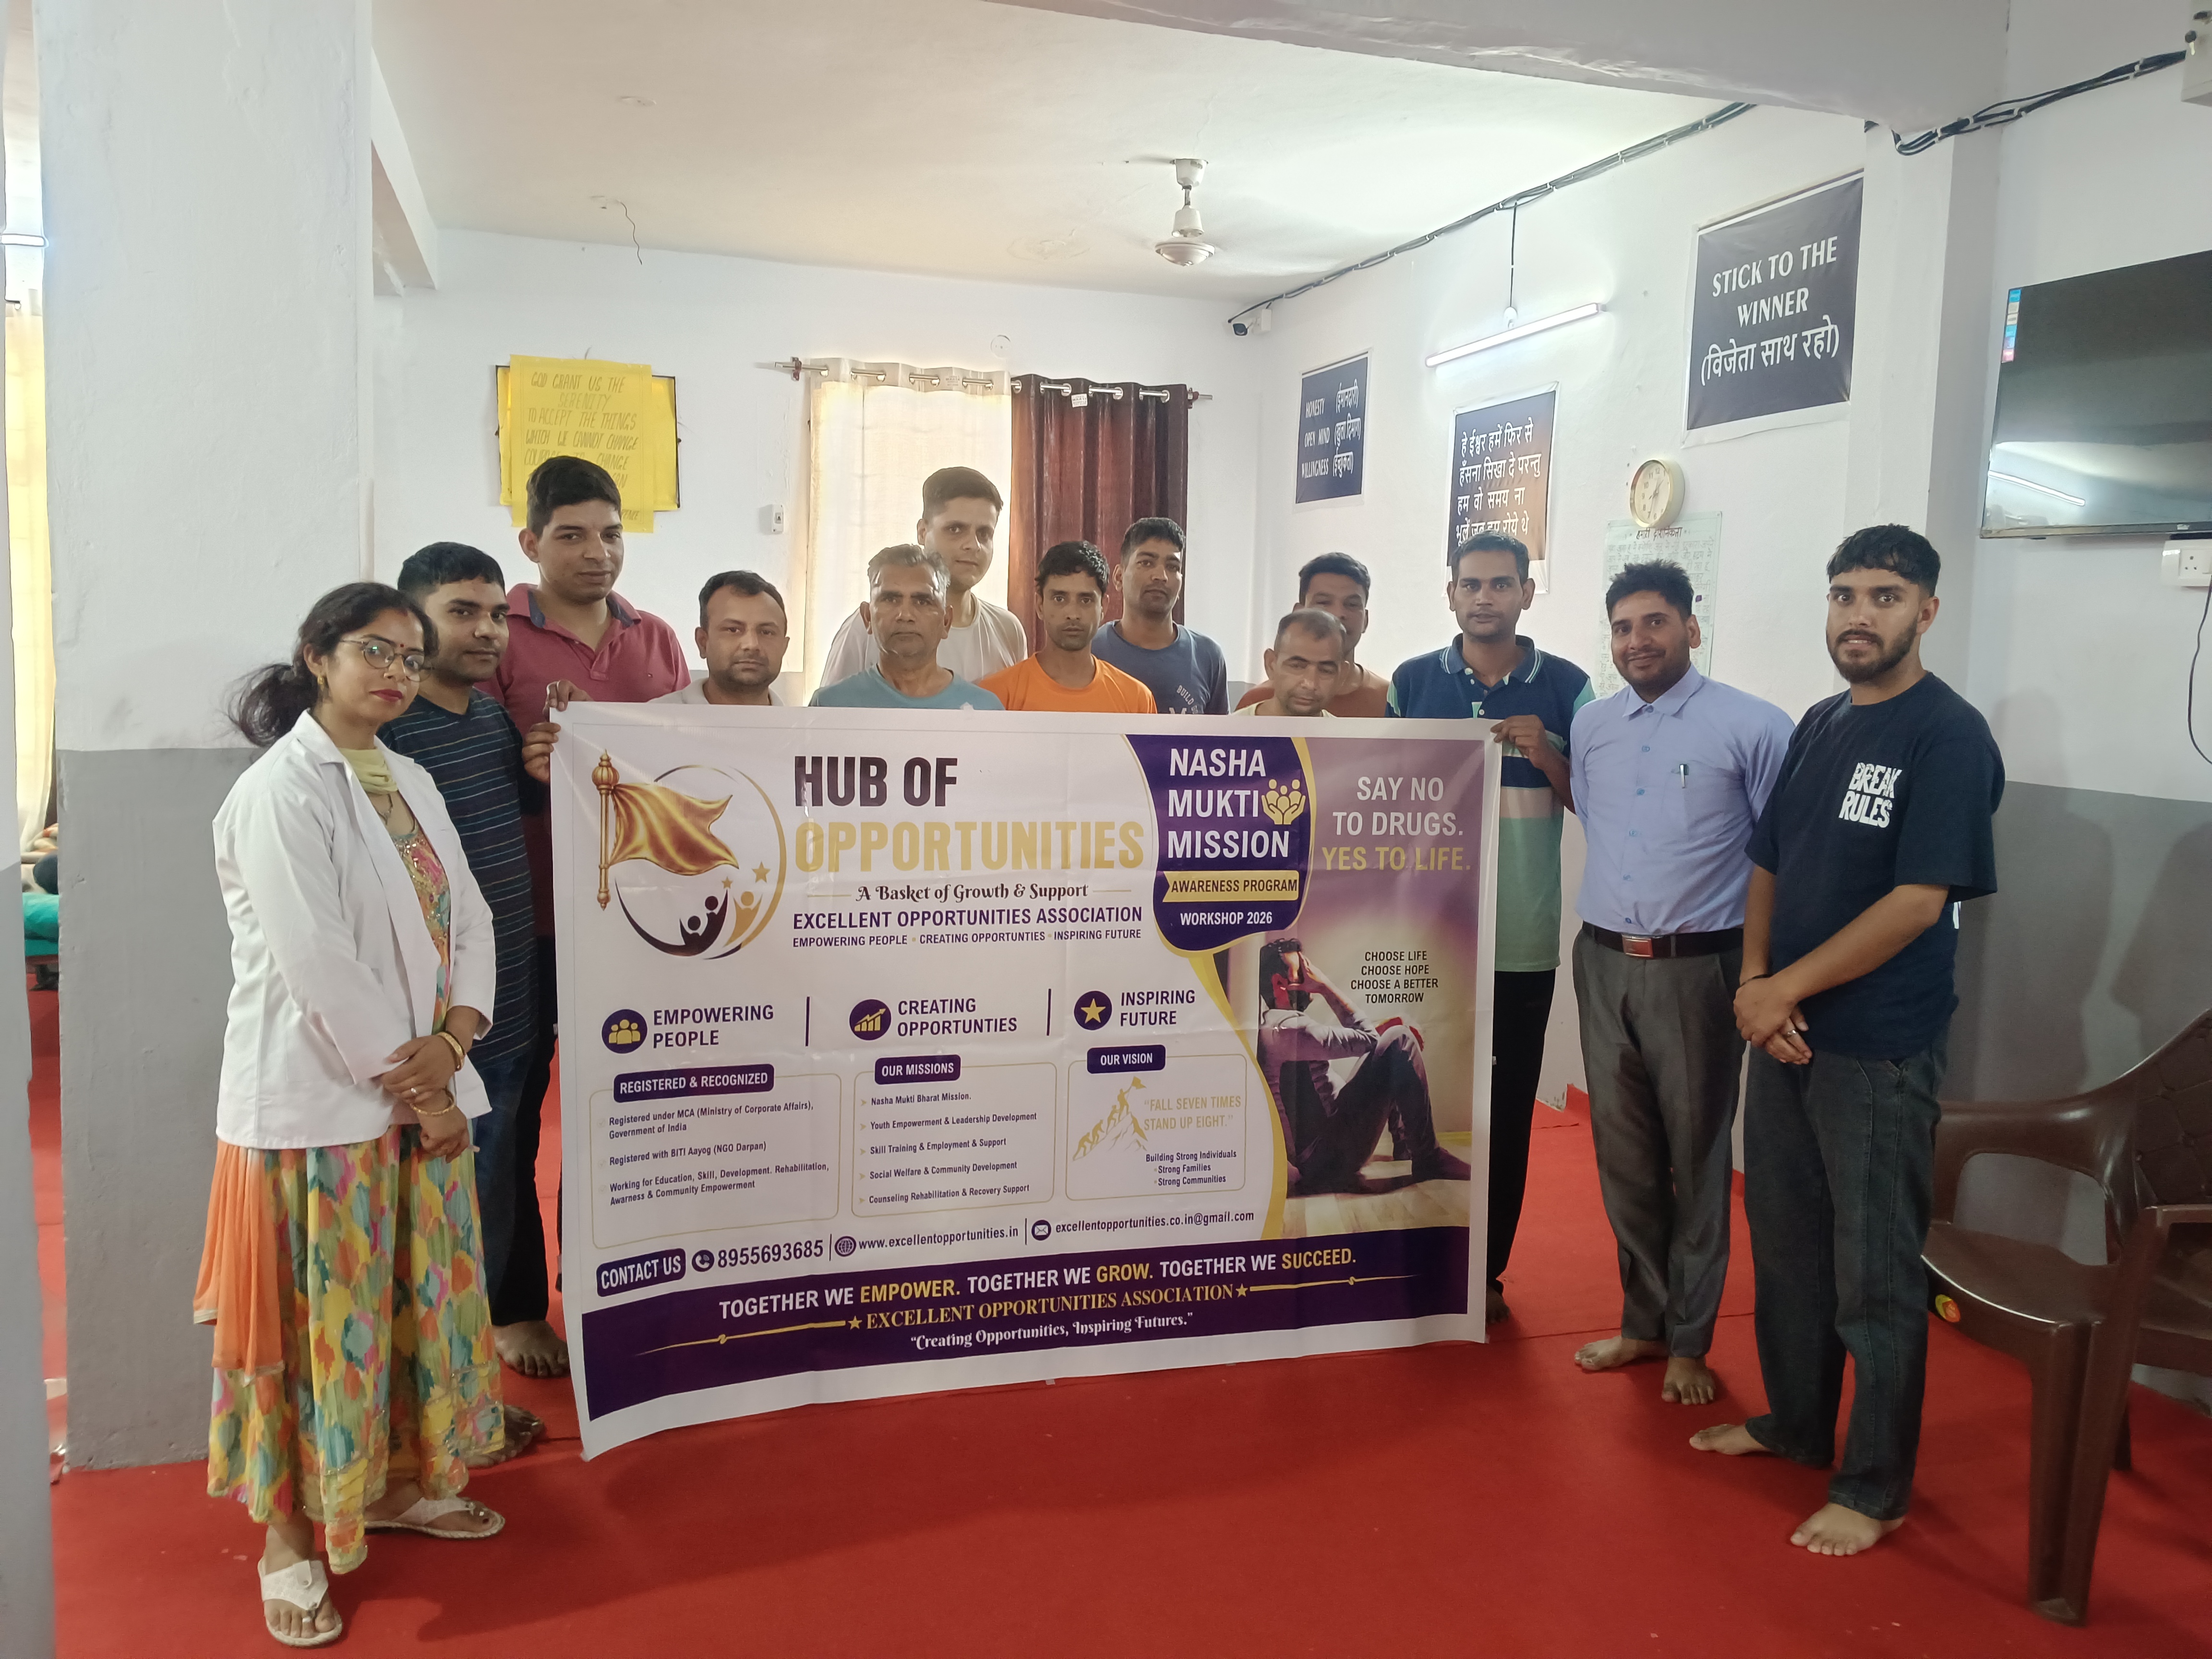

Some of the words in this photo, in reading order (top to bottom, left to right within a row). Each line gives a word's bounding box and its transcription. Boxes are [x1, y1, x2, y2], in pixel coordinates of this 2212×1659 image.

[1713, 260, 1763, 297] STICK
[1768, 251, 1793, 280] TO
[1800, 236, 1837, 270] THE
[1737, 288, 1809, 328] WINNER
[1701, 338, 1756, 385] (विजेता
[1761, 333, 1797, 367] साथ
[1802, 314, 1839, 359] रहो)
[531, 372, 547, 387] GOD
[553, 373, 582, 389] GRANT
[589, 376, 601, 391] US
[608, 377, 625, 393] THE
[559, 393, 610, 411] SERENITY
[1335, 379, 1359, 413] (ईमानदारी)
[528, 408, 536, 421] TO
[539, 409, 572, 427] ACCEPT
[579, 412, 596, 428] THE
[602, 413, 637, 431] THINGS
[1306, 398, 1325, 419] HONESTY
[526, 429, 549, 445] WHICH
[558, 430, 568, 447] WE
[574, 431, 603, 449] CANNOT
[607, 433, 638, 450] CHANGE
[1304, 430, 1315, 447] OPEN
[1318, 427, 1330, 445] MIND
[1334, 421, 1346, 449] (खुला
[1346, 413, 1361, 441] दिमाग)
[1461, 431, 1468, 457] हे
[1469, 428, 1486, 456] ईश्वर
[1488, 423, 1503, 452] हमें
[1503, 421, 1522, 447] फिर
[1524, 417, 1534, 443] से
[1301, 458, 1329, 479] WILLINGNESS
[1459, 458, 1481, 487] हँसना
[1483, 456, 1506, 485] सिखा
[1508, 451, 1515, 478] दे
[1518, 452, 1541, 478] परन्तु
[1457, 495, 1470, 516] हम
[1474, 487, 1483, 511] वो
[1487, 489, 1509, 509] समय
[1514, 487, 1526, 505] ना
[1503, 512, 1518, 535] रोये
[1522, 510, 1529, 535] थे
[1177, 685, 1194, 705] BUILD
[1170, 748, 1266, 777] NASHA
[794, 756, 888, 807] HUB
[903, 757, 958, 807] OF
[1849, 762, 1903, 798] BREAK
[1168, 790, 1260, 817] MUKTI
[1839, 791, 1893, 828] RULES
[795, 821, 1144, 873] OPPORTUNITIES
[1167, 830, 1289, 859] MISSION
[855, 885, 871, 902] A
[876, 886, 930, 901] Basket
[934, 885, 950, 902] of
[953, 883, 1009, 902] Growth
[1013, 884, 1026, 898] &
[1030, 883, 1089, 902] Support
[1171, 880, 1239, 893] AWARENESS
[1243, 879, 1297, 892] PROGRAM
[1180, 912, 1244, 926] WORKSHOP
[1247, 912, 1273, 925] 2026
[793, 935, 866, 948] EMPOWERING
[869, 935, 908, 946] PEOPLE
[919, 932, 968, 944] CREATING
[972, 931, 1046, 942] OPPORTUNTIES
[1053, 930, 1102, 941] INSPIRING
[1105, 929, 1141, 939] FUTURE
[1350, 979, 1391, 989] CHOOSE
[1394, 980, 1400, 988] A
[1404, 978, 1438, 988] BETTER
[1365, 992, 1424, 1004] TOMORROW
[620, 1077, 686, 1094] REGISTERED
[689, 1077, 697, 1088] &
[701, 1072, 768, 1088] RECOGNIZED
[871, 1097, 893, 1106] Nasha
[895, 1095, 915, 1104] Mukti
[917, 1094, 939, 1103] Bharat
[942, 1093, 971, 1101] Mission.
[1176, 1097, 1207, 1109] SEVEN
[1211, 1096, 1241, 1108] TIMES
[609, 1113, 650, 1127] Registered
[653, 1111, 674, 1120] under
[677, 1109, 695, 1118] MCA
[697, 1106, 733, 1118] (Ministry
[735, 1106, 742, 1115] of
[745, 1104, 781, 1115] Corporate
[870, 1121, 890, 1130] Youth
[892, 1118, 942, 1129] Empowerment
[952, 1115, 990, 1126] Leadership
[992, 1113, 1037, 1124] Development
[1144, 1118, 1176, 1130] STAND
[1180, 1118, 1193, 1129] UP
[609, 1126, 655, 1140] Government
[658, 1124, 665, 1133] of
[668, 1123, 687, 1131] India
[610, 1153, 650, 1166] Registered
[652, 1150, 668, 1159] with
[688, 1147, 711, 1157] Aayog
[714, 1144, 733, 1155] (NGO
[736, 1142, 767, 1152] Darpan)
[870, 1146, 886, 1154] Skill
[889, 1143, 917, 1153] Training
[927, 1140, 970, 1152] Employment
[979, 1138, 1006, 1148] Support
[1146, 1154, 1174, 1162] Building
[1176, 1152, 1198, 1161] Strong
[1200, 1150, 1237, 1159] Individuals
[610, 1179, 640, 1192] Working
[642, 1178, 653, 1187] for
[655, 1173, 695, 1185] Education,
[697, 1170, 717, 1181] Skill,
[869, 1193, 909, 1203] Counseling
[911, 1190, 960, 1201] Rehabilitation
[969, 1186, 1001, 1196] Recovery
[1003, 1185, 1030, 1194] Support
[718, 1239, 823, 1268] 8955693685
[859, 1226, 1019, 1250] www.excellentopportunities.in
[1056, 1211, 1254, 1235] excellentopportunities.co.in@gmail.com
[601, 1260, 659, 1290] CONTACT
[663, 1257, 681, 1274] US
[866, 1305, 974, 1329] EXCELLENT
[979, 1293, 1118, 1319] OPPORTUNITIES
[1121, 1284, 1234, 1307] ASSOCIATION
[976, 1323, 1070, 1346] Opportunities,
[1072, 1318, 1132, 1336] Inspiring
